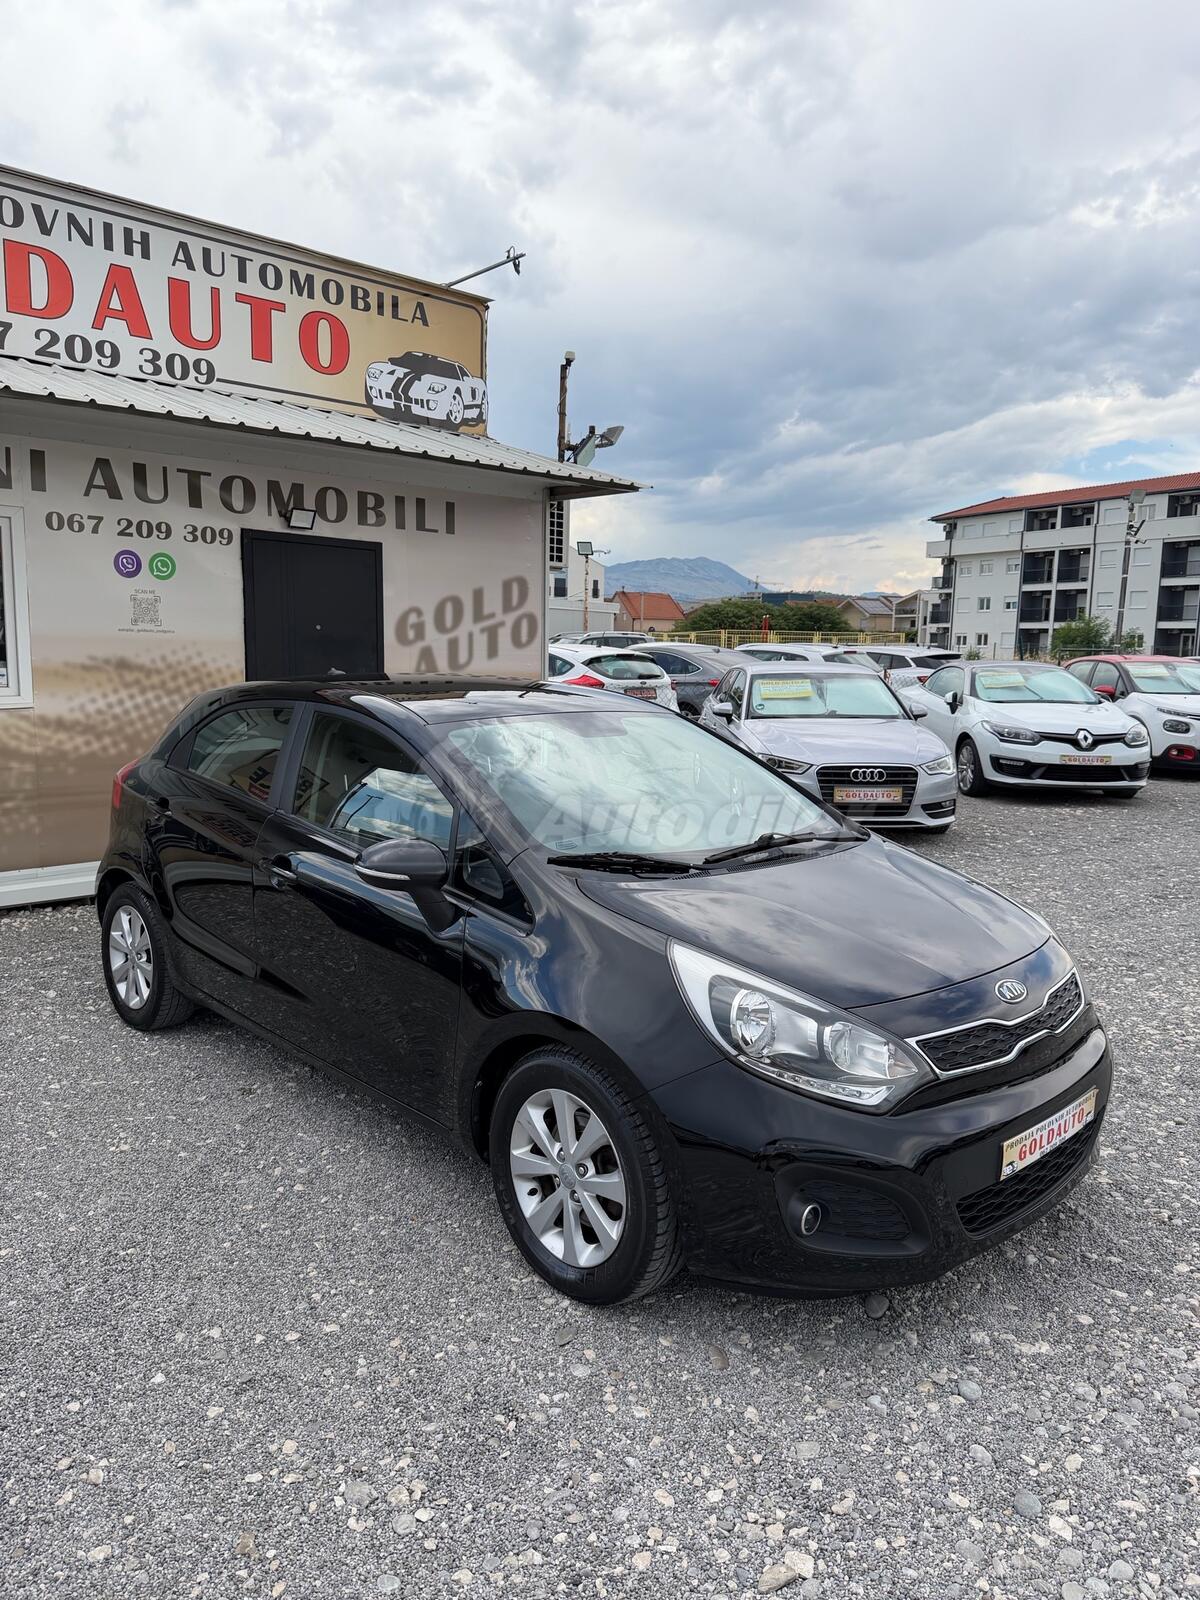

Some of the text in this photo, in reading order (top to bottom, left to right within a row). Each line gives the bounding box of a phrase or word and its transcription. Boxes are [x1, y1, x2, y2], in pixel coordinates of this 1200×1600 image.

[0, 195, 430, 328] OVNIH AUTOMOBILA
[3, 238, 351, 376] DAUTO
[34, 328, 121, 369] 209
[138, 347, 216, 386] 309
[83, 457, 456, 535] AUTOMOBILI
[45, 511, 234, 546] 067 209 309
[395, 575, 529, 647] GOLD
[415, 611, 538, 673] AUTO
[999, 981, 1025, 1000] KIA
[1018, 1107, 1085, 1162] GOLDAUTO
